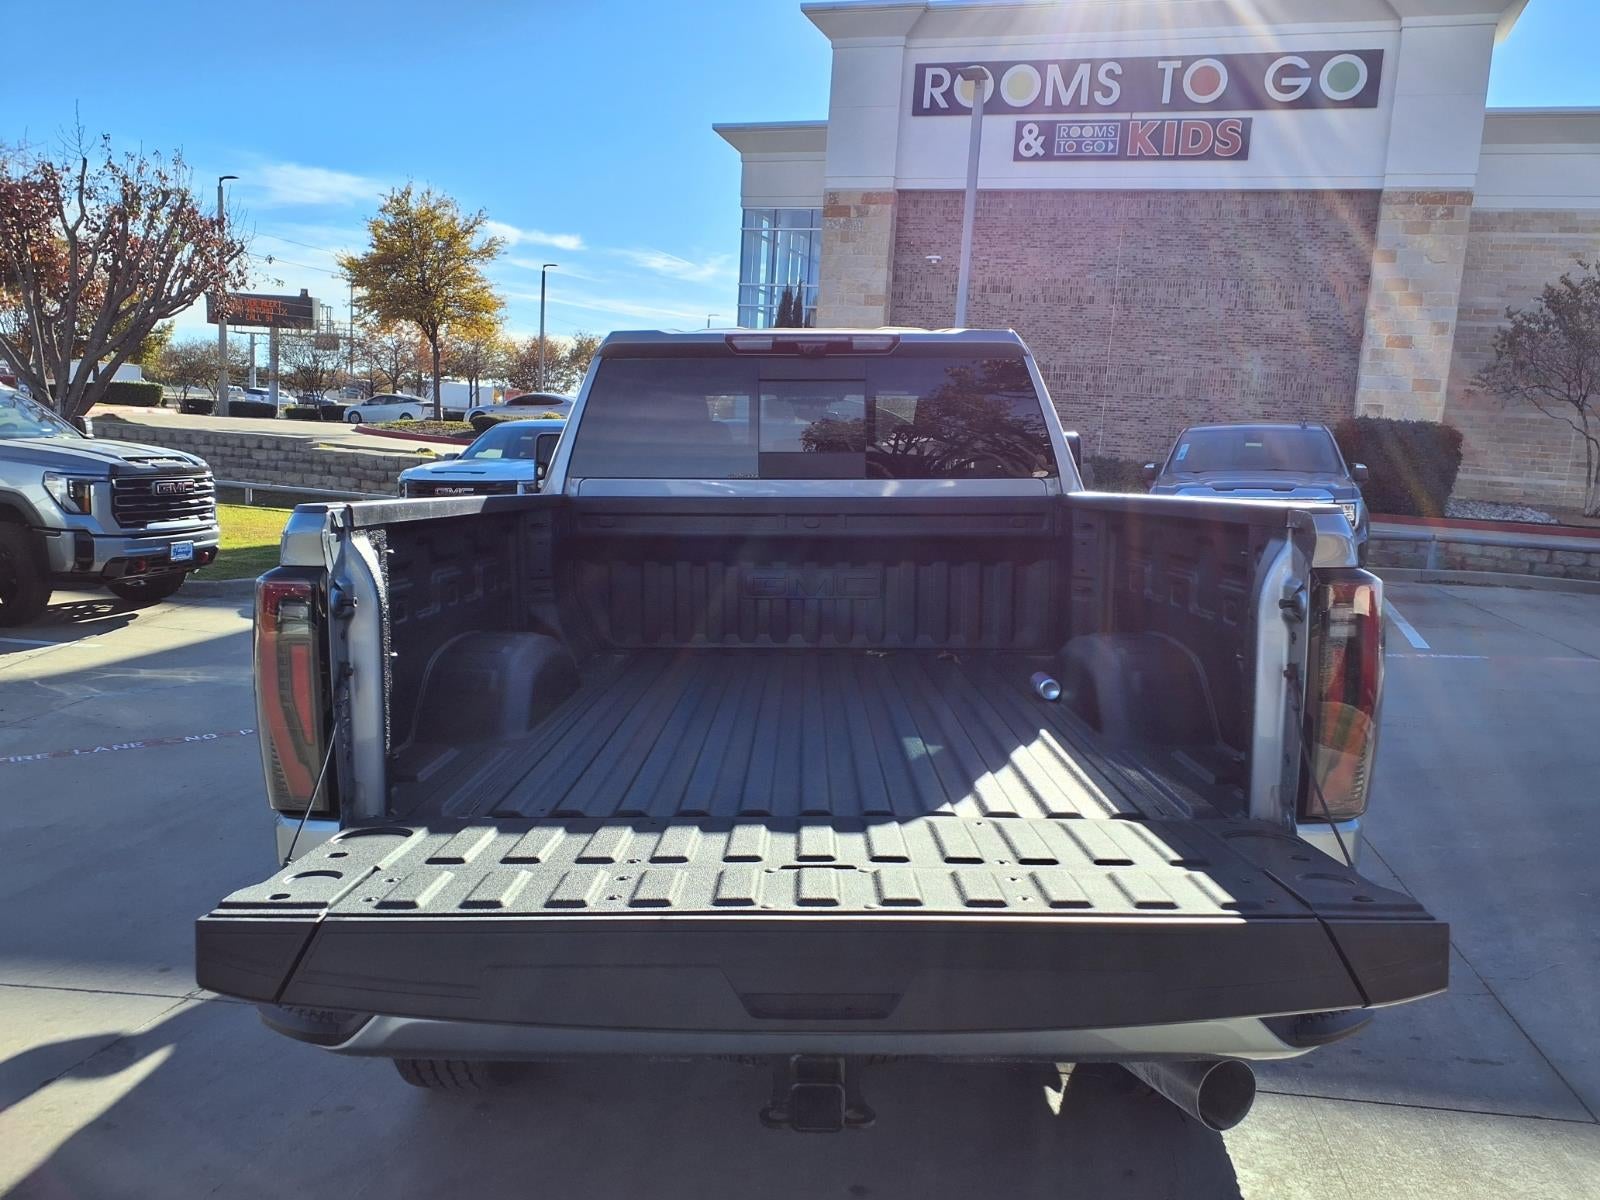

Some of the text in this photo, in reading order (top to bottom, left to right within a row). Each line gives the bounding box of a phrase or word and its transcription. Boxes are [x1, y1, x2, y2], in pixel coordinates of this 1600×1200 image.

[922, 53, 1368, 109] ROOMS TO GO
[1060, 125, 1116, 138] ROOMS
[1127, 119, 1243, 157] KIDS
[1018, 122, 1045, 158] &
[1058, 139, 1106, 153] TO GO
[156, 481, 194, 495] GMC
[184, 733, 218, 742] NO
